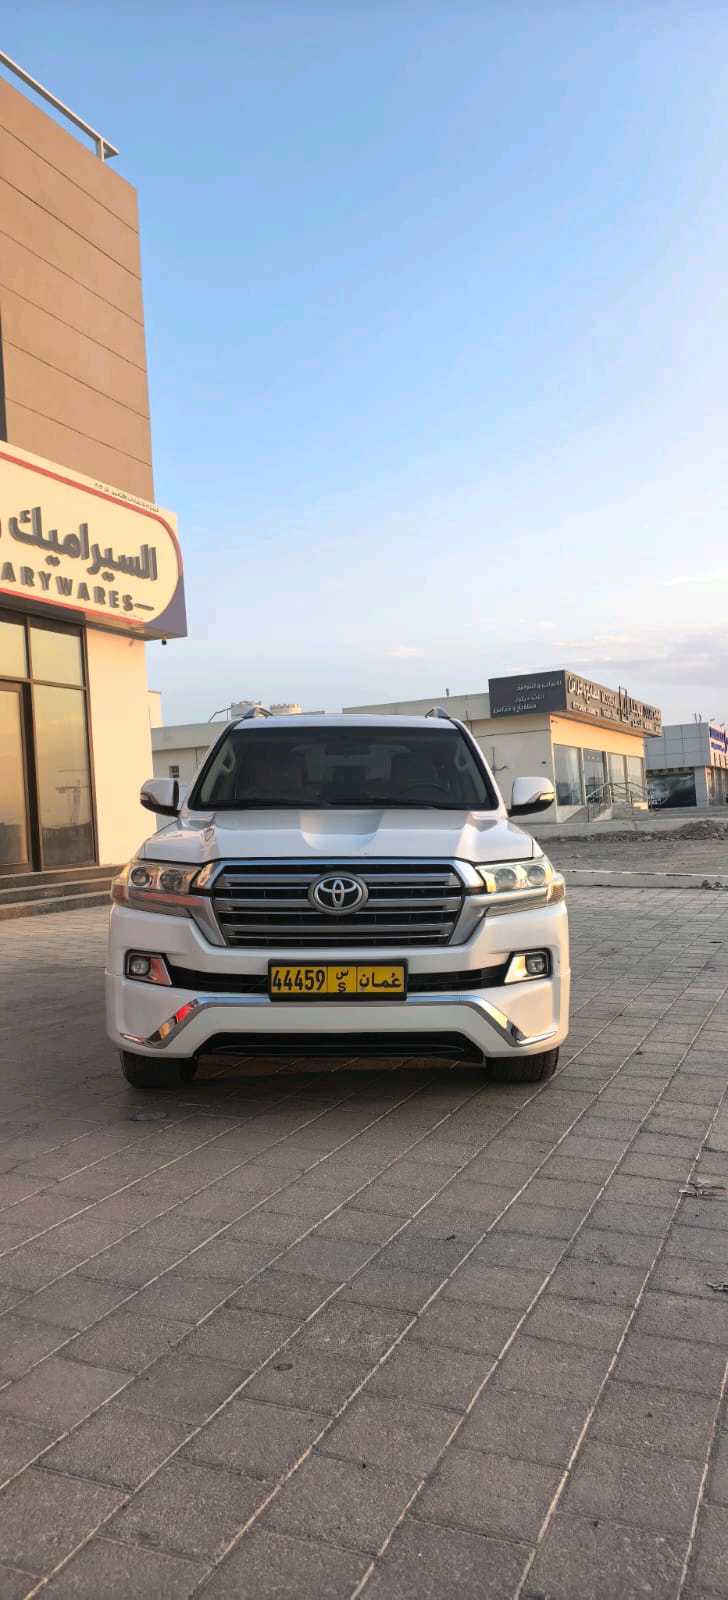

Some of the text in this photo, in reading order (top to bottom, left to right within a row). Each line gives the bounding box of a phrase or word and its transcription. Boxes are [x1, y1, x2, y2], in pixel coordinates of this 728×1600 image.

[8, 506, 158, 582] السيراميك
[273, 969, 326, 991] 44459
[335, 969, 349, 980] س
[337, 982, 347, 992] S
